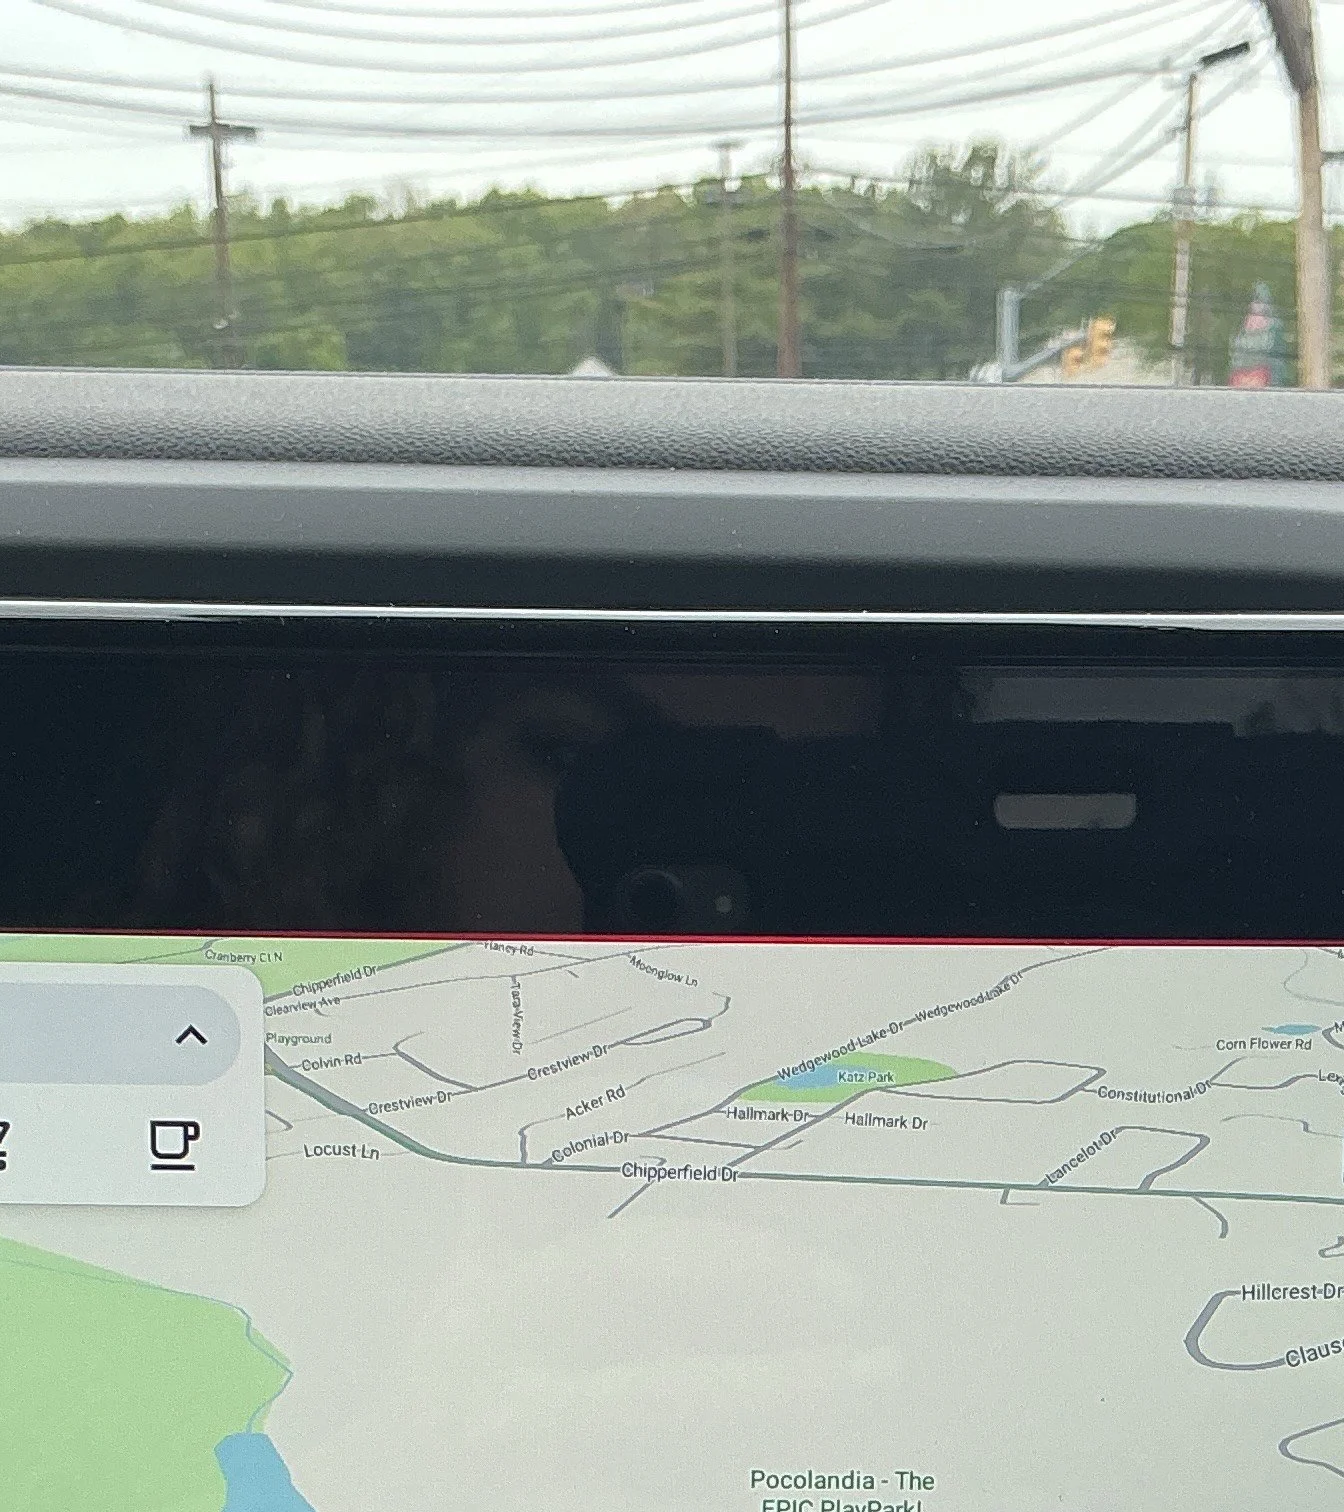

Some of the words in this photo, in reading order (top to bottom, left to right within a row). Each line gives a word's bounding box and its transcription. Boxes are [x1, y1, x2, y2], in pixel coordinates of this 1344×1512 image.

[205, 949, 256, 965] Cranberry
[293, 967, 362, 996] Chipperfield
[364, 965, 377, 978] Dr
[265, 1001, 316, 1016] Clearview
[318, 996, 340, 1008] Ave
[915, 994, 984, 1023] Wedgewood
[985, 982, 1011, 1002] Lake
[1010, 971, 1023, 985] Dr
[266, 1032, 332, 1046] Playground
[1216, 1039, 1246, 1051] Corn
[1250, 1038, 1290, 1051] Flower
[1295, 1038, 1312, 1050] Rd
[776, 1038, 856, 1080] Wedgewood
[857, 1026, 887, 1051] Lake
[889, 1021, 905, 1035] Dr
[301, 1058, 342, 1072] Colvin
[345, 1053, 362, 1066] Rd
[527, 1051, 591, 1081] Crestview
[592, 1044, 608, 1059] Dr
[838, 1071, 864, 1082] Katz
[868, 1071, 894, 1082] Park
[1097, 1083, 1194, 1103] Constitutional
[1196, 1078, 1211, 1095] Dr
[368, 1096, 435, 1115] Crestview
[437, 1090, 453, 1104] Dr
[565, 1096, 603, 1120] Acker
[606, 1084, 626, 1103] Rd
[726, 1107, 789, 1121] Hallmark
[793, 1109, 809, 1122] Dr
[845, 1113, 907, 1129] Hallmark
[912, 1117, 928, 1130] Dr
[304, 1144, 356, 1158] Locust
[361, 1145, 379, 1161] Ln
[552, 1132, 609, 1163] Colonial
[613, 1129, 629, 1143] Dr
[1045, 1139, 1100, 1184] Lancelot
[1100, 1129, 1118, 1147] Dr
[621, 1162, 717, 1182] Chipperfield
[721, 1166, 739, 1182] Dr
[1241, 1283, 1318, 1301] Hillcrest
[1323, 1284, 1344, 1300] Dr
[751, 1470, 874, 1491] Pocolandia
[895, 1472, 935, 1491] The
